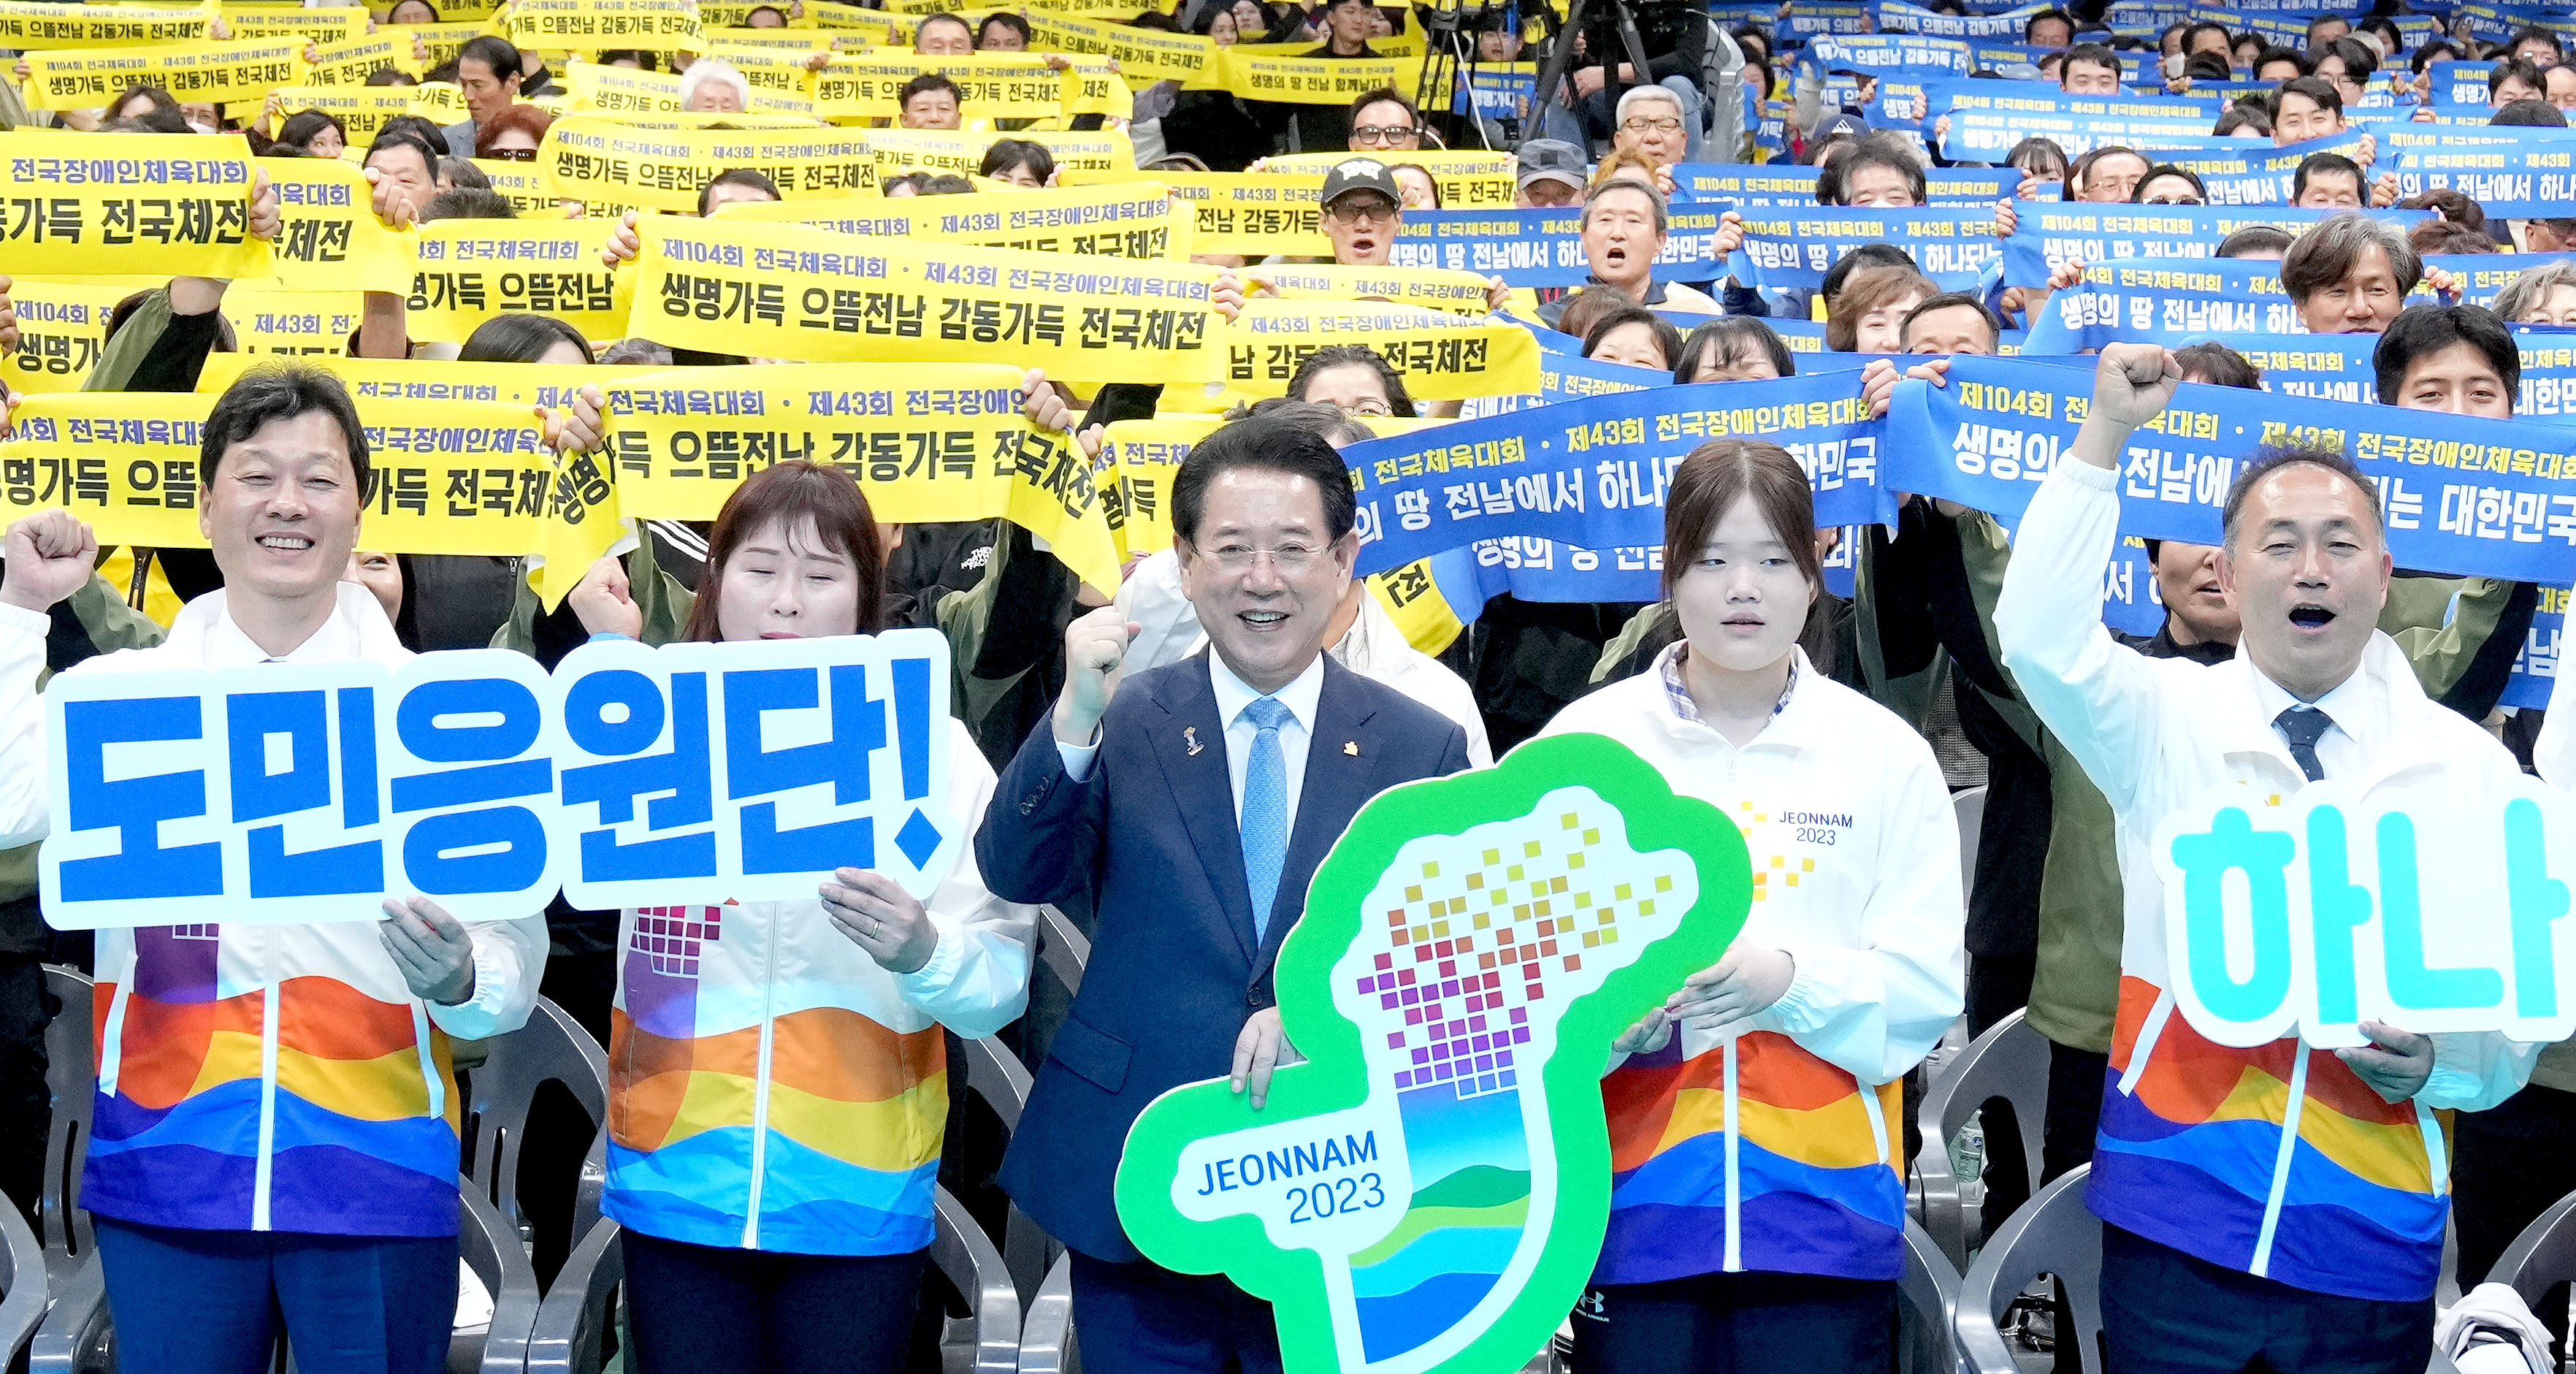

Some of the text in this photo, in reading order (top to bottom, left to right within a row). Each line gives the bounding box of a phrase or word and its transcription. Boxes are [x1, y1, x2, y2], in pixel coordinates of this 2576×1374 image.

[29, 20, 205, 39] 으뜸전남 감동가득 전국체전
[543, 16, 595, 34] 으뜸전남
[602, 16, 653, 34] 감동가득
[700, 9, 744, 23] 감동가득
[1064, 37, 1203, 69] 으뜸전남 감동가득 전국체전
[49, 63, 290, 95] 생명가득 감동가득 전국체전
[308, 67, 335, 87] 가득
[819, 80, 1001, 101] 생명가득 동가득
[1078, 82, 1109, 98] 체전
[596, 92, 651, 111] 생명가득
[1884, 99, 1914, 118] 생명
[557, 131, 604, 148] 제104회
[611, 139, 689, 158] 전국체육대회
[712, 148, 754, 159] 제43회
[12, 159, 247, 184] 전국장애인체육대회
[557, 152, 874, 191] 생명가득 으뜸전남 전국체전
[2401, 153, 2418, 167] 회
[2526, 153, 2570, 167] 제43회
[1233, 188, 1276, 201] 제43회
[1694, 177, 1740, 191] 제104회
[2206, 178, 2277, 205] 전남에서
[2456, 174, 2531, 201] 전남에서
[102, 198, 248, 244] 전국체전
[941, 214, 1000, 232] 제43회
[1010, 199, 1167, 229] 전국장애인체육대회
[1193, 209, 1322, 234] 전남 감동가득
[1397, 222, 1430, 237] 04회
[1438, 221, 1520, 237] 전국체육대회
[1797, 221, 1884, 237] 전국체육대회
[1907, 221, 1954, 237] 제43회
[2042, 215, 2193, 234] 제104회 전국체육대회
[456, 240, 578, 260] 전국체육대회
[1445, 243, 1466, 270] 땅
[1472, 242, 1548, 270] 전남에서
[1807, 243, 1828, 270] 땅
[663, 239, 1209, 302] 제104회 전국체육대회 제43회 전국장애인체육대회
[2120, 270, 2221, 293] 전국체육대회
[500, 272, 614, 310] 으뜸전남
[1355, 280, 1401, 295] 제43회
[14, 299, 88, 324] 제104회
[255, 313, 320, 334] 제43회
[661, 272, 1207, 350] 생명가득 으뜸전남 감동가득 전국체전
[1250, 316, 1310, 333] 제43회
[2060, 291, 2256, 332] 생명의 땅 전남에서
[1231, 338, 1488, 379] 남 전국체전
[2520, 349, 2576, 367] 인체육
[537, 386, 584, 408] 제4
[608, 390, 893, 416] 전국체육대회 제43회
[1958, 381, 2054, 419] 제104회
[68, 419, 206, 445] 전국체육대
[1374, 397, 1870, 483] 전국체육대회 제43회 전국장애인체육대회
[1093, 443, 1190, 472] 4회 전국체
[0, 458, 109, 506] 명가득
[127, 459, 199, 509] 으뜸
[446, 468, 551, 517] 전국체
[832, 430, 1096, 519] 감동가득 전국체전
[1952, 422, 2060, 481] 생명의
[2439, 484, 2576, 546] 대한민국
[1357, 500, 1383, 546] 의
[1394, 489, 1431, 531] 땅
[1444, 468, 1584, 520] 전남에서
[1597, 456, 1680, 514] 하나
[1381, 564, 1430, 608] 전
[2512, 627, 2559, 675] 남
[59, 658, 942, 902] 도민응원단!
[1780, 812, 1852, 828] JEONNAM
[1797, 828, 1835, 845] 2023
[1198, 1130, 1377, 1196] JEONNAM
[1286, 1172, 1384, 1224] 2023
